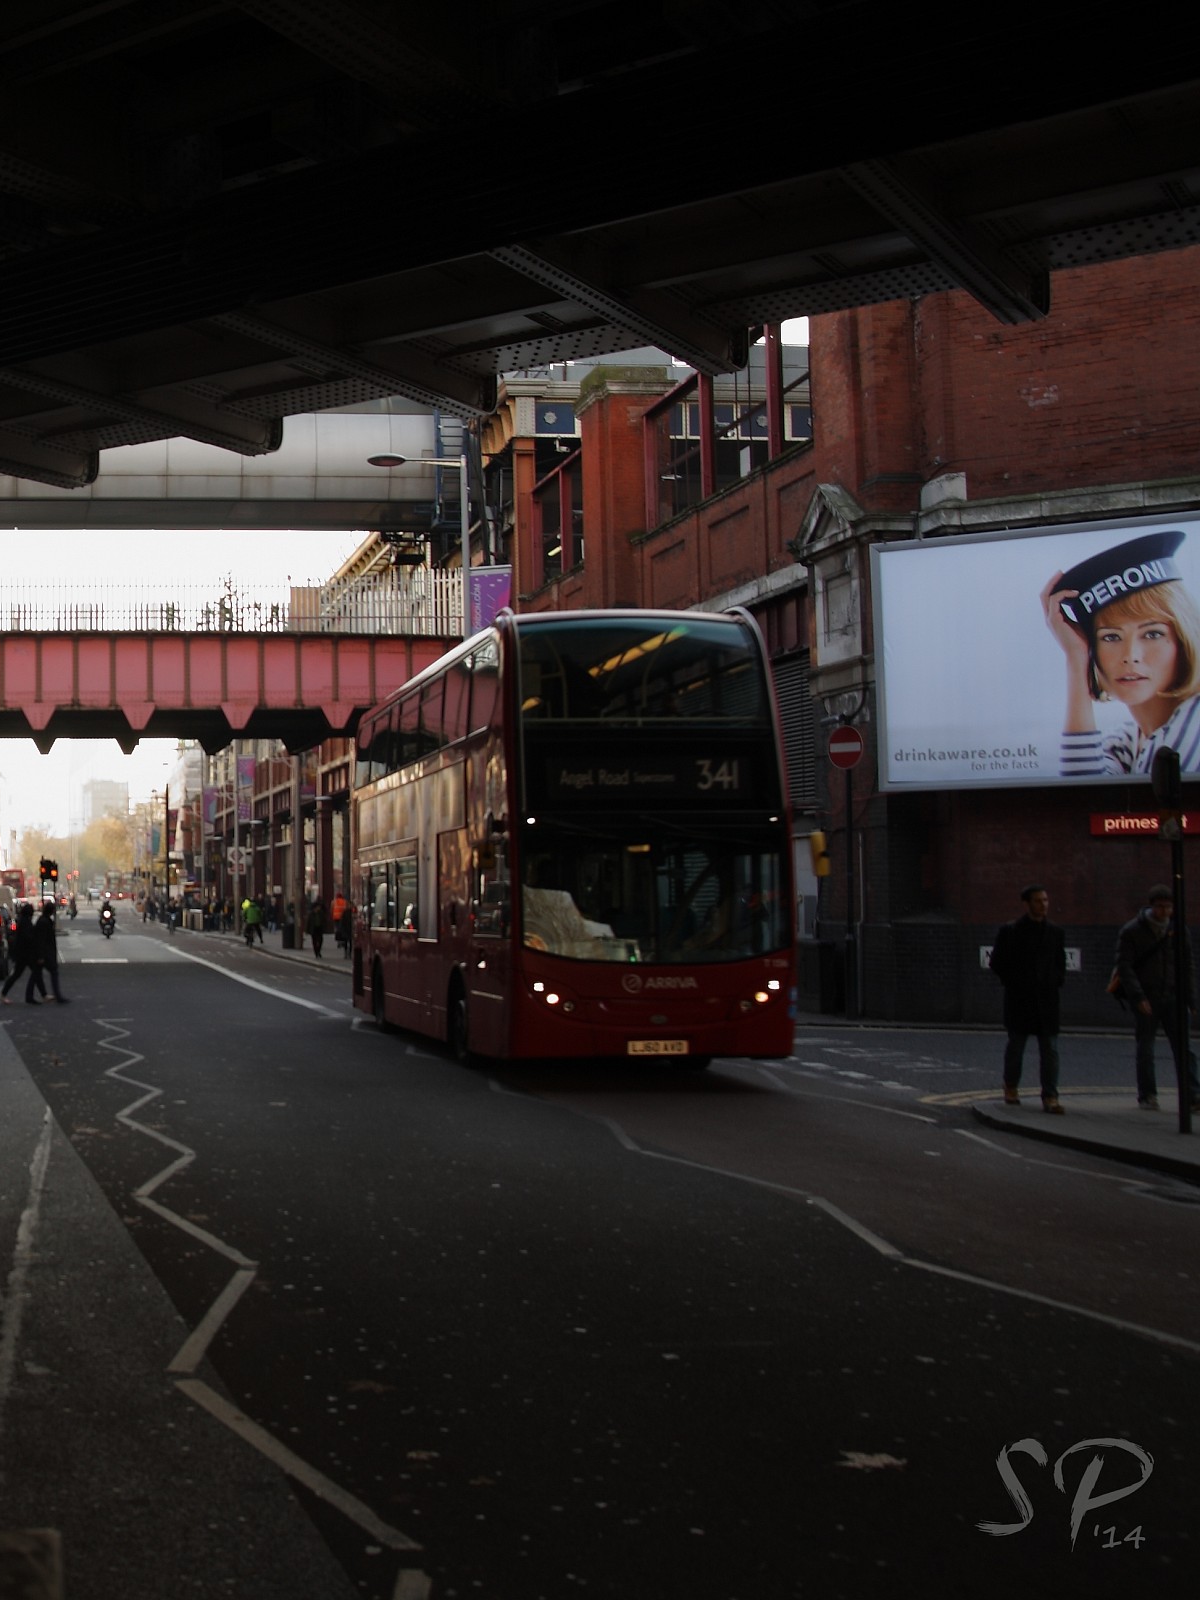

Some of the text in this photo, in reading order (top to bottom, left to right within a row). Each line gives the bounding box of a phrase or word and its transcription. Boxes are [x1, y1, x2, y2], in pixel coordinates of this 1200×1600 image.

[1079, 560, 1166, 613] PERONI
[895, 745, 1038, 762] drinkaware.co.uk
[971, 759, 1039, 771] for the facts
[560, 769, 593, 790] Angel
[599, 768, 630, 786] Road
[695, 759, 740, 790] 341
[1104, 814, 1188, 832] primest
[645, 976, 698, 989] ARRIVA
